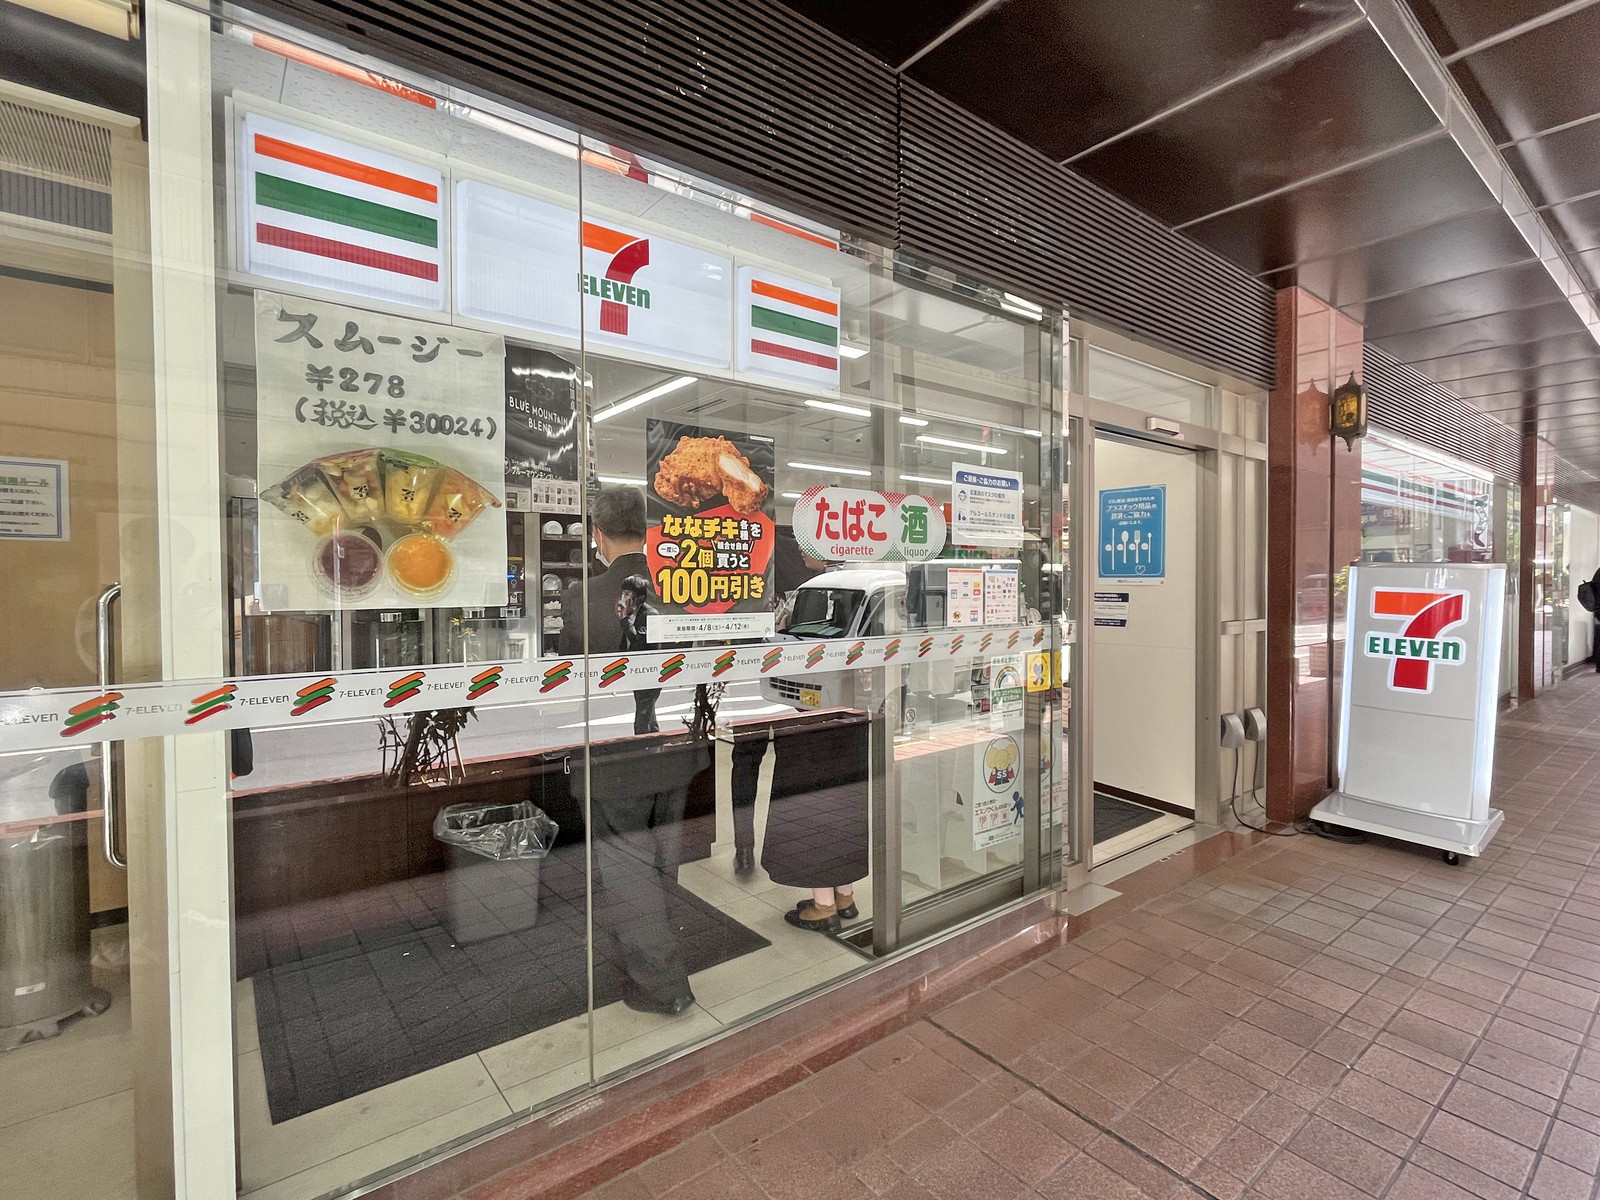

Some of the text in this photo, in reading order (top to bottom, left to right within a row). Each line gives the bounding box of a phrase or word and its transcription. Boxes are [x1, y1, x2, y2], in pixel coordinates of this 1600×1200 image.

[274, 308, 483, 363] スムージー
[305, 363, 406, 399] ¥278
[509, 396, 568, 427] BLUE MOUNTAIN
[528, 417, 553, 434] BLEND
[815, 496, 888, 542] たばこ
[901, 504, 928, 544] 酒
[830, 544, 874, 556] cigarette
[903, 546, 929, 558] liquor
[658, 568, 765, 604] 100円引き
